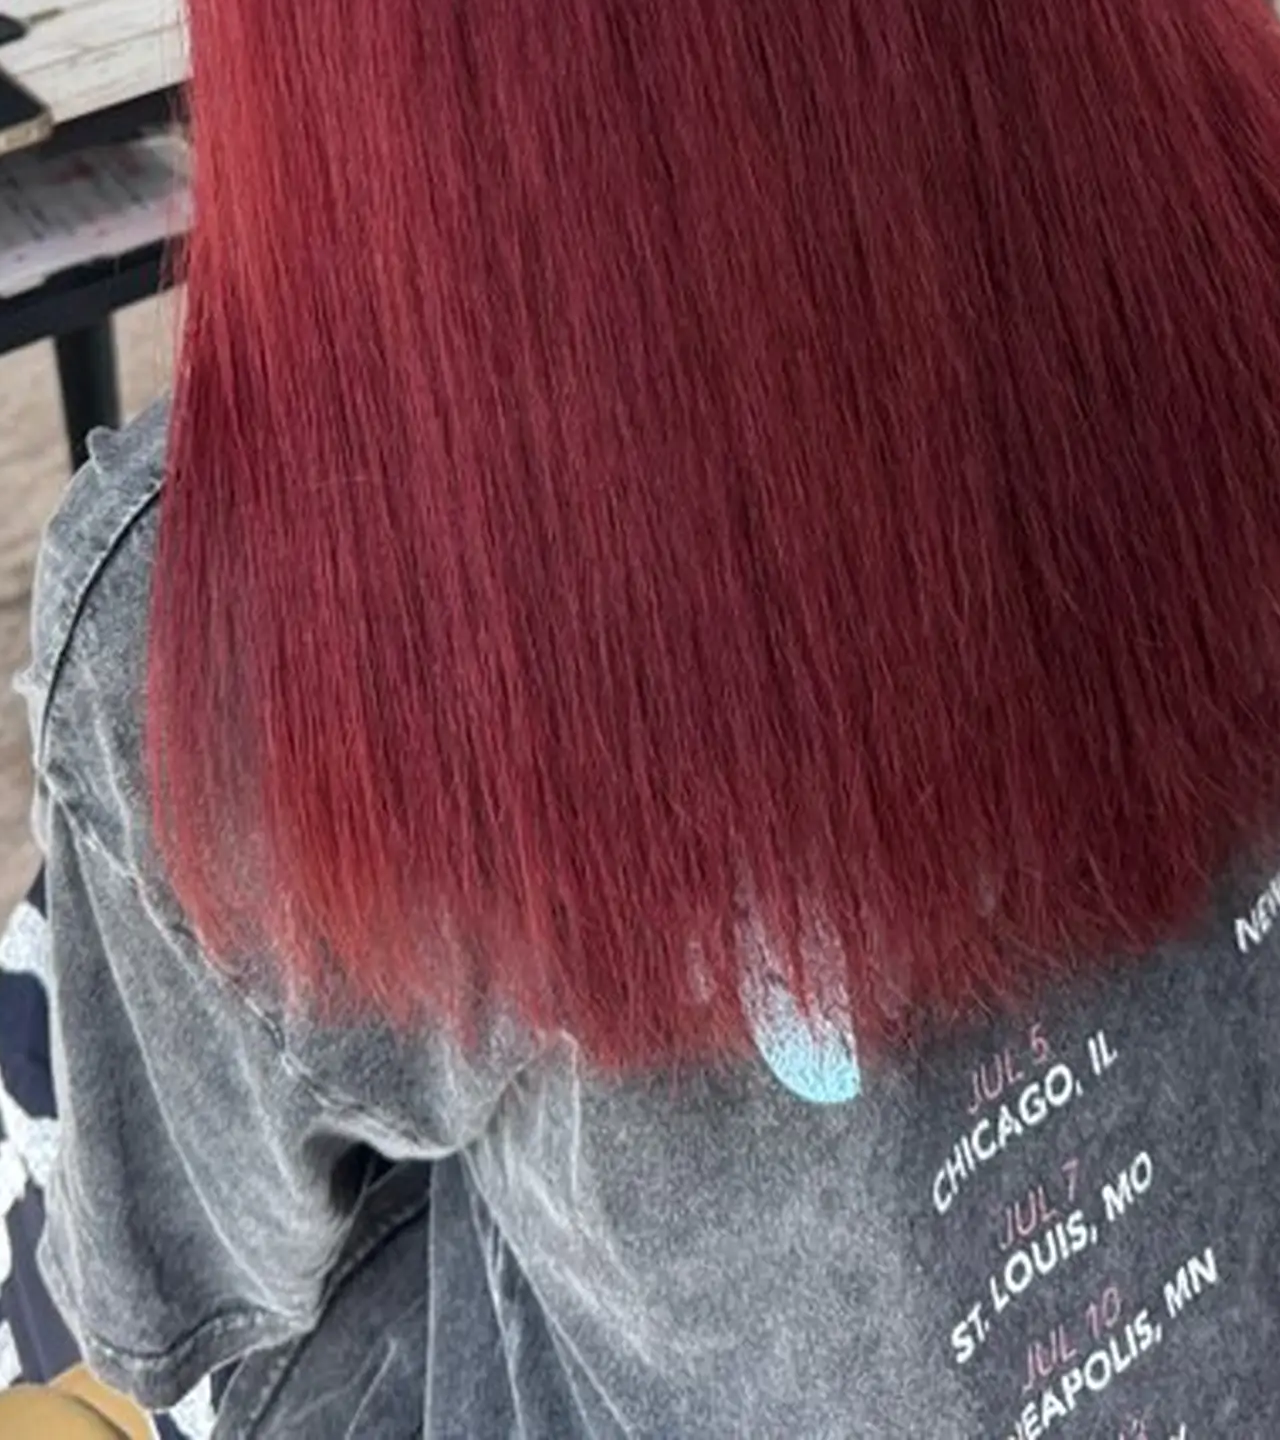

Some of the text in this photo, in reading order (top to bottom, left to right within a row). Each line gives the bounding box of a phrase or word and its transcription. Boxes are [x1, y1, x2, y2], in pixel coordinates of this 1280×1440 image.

[932, 1029, 1119, 1215] CHICAGO, IL
[968, 1047, 1024, 1115] JUL
[950, 1151, 1153, 1364] ST. LOUIS, MO
[998, 1156, 1080, 1251] JUL 7
[1007, 1246, 1219, 1440] EAPOLIS, MN
[1023, 1286, 1122, 1392] JUL 10
